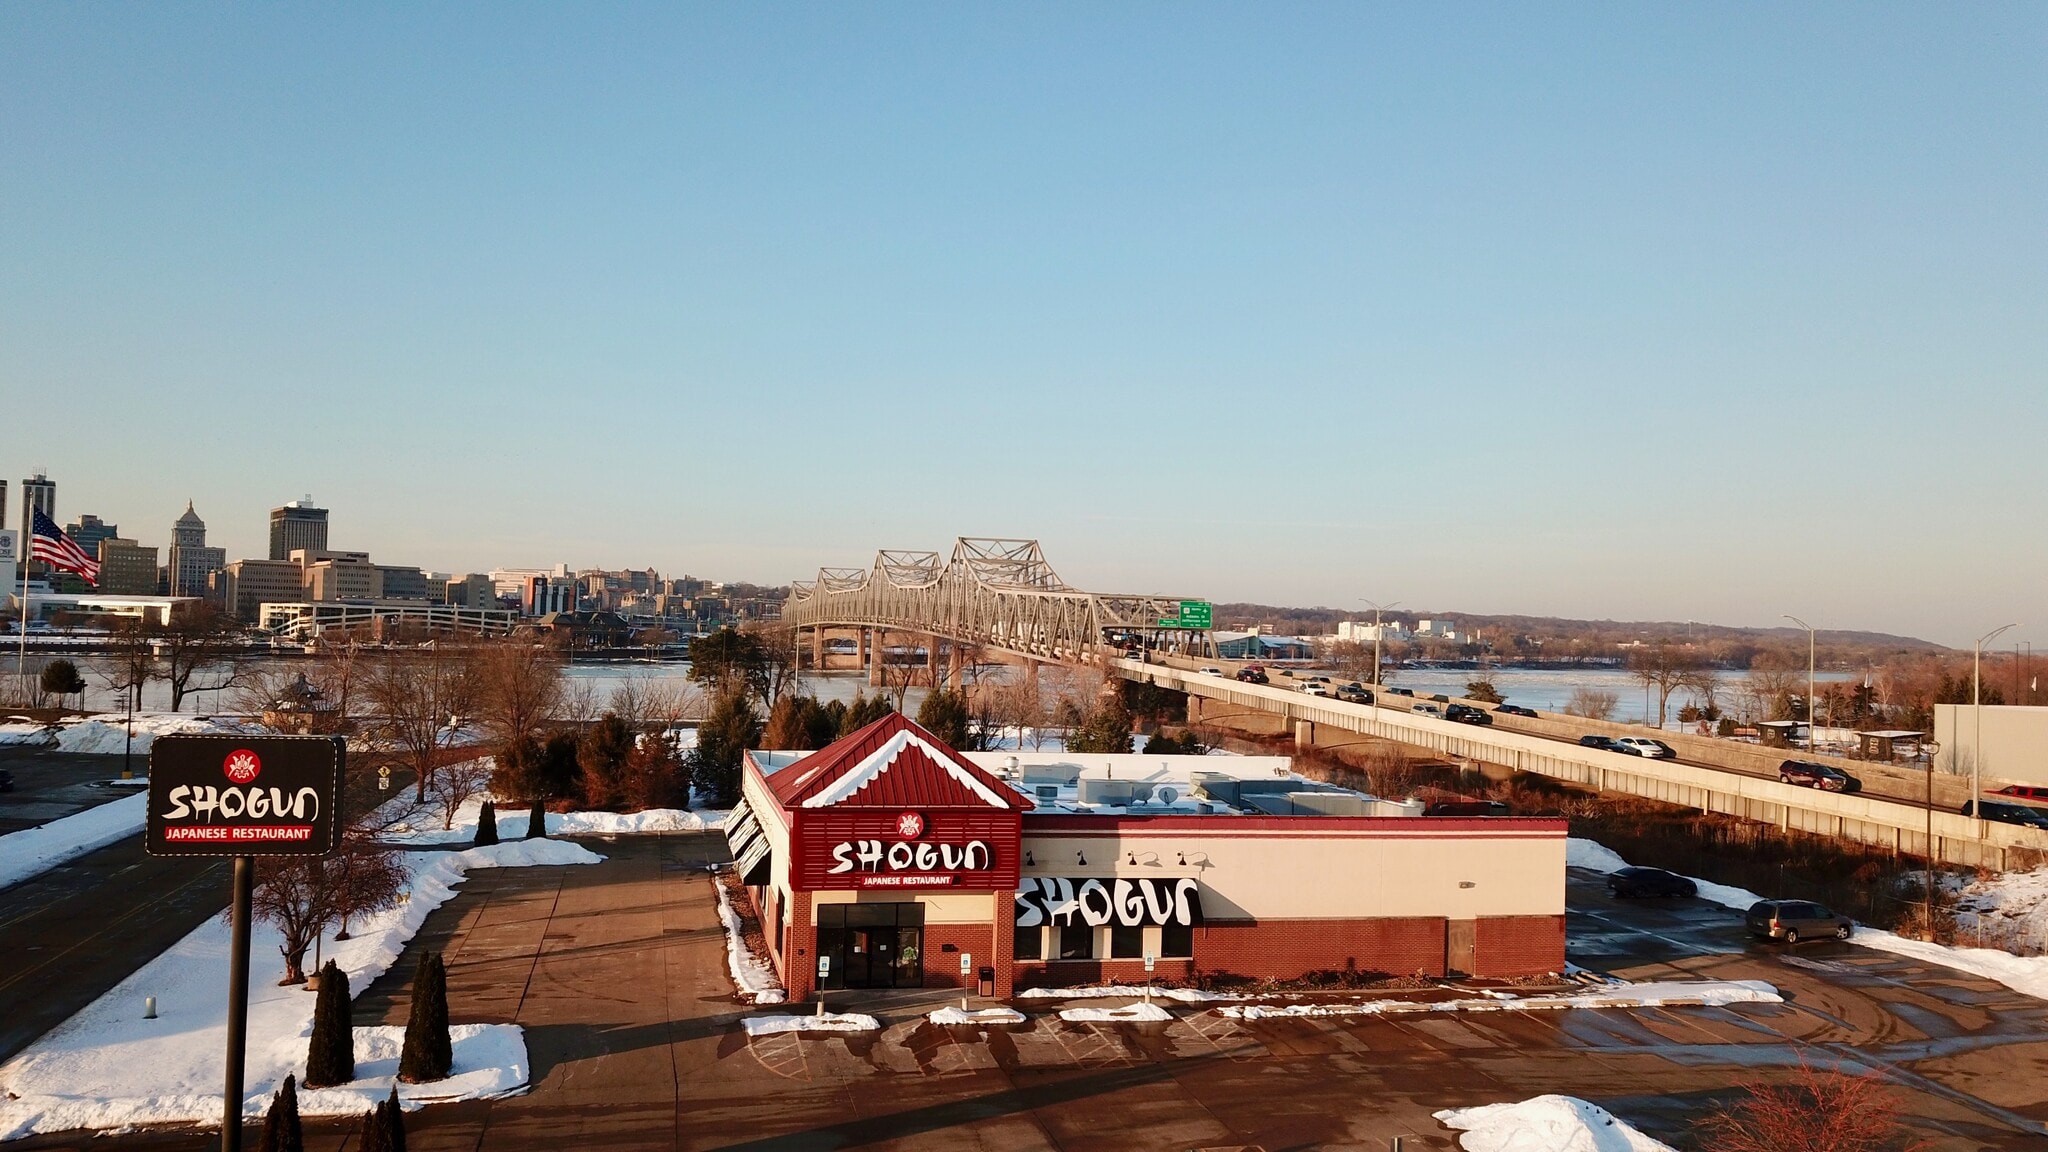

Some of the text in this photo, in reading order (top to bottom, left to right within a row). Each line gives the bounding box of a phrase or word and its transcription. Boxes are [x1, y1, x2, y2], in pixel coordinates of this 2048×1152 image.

[161, 784, 319, 824] SHOGUN
[166, 828, 311, 839] JAPANESE RESTAURANT
[827, 840, 989, 874] SHOGUN
[863, 876, 950, 885] JAPANESE RESTAURANT
